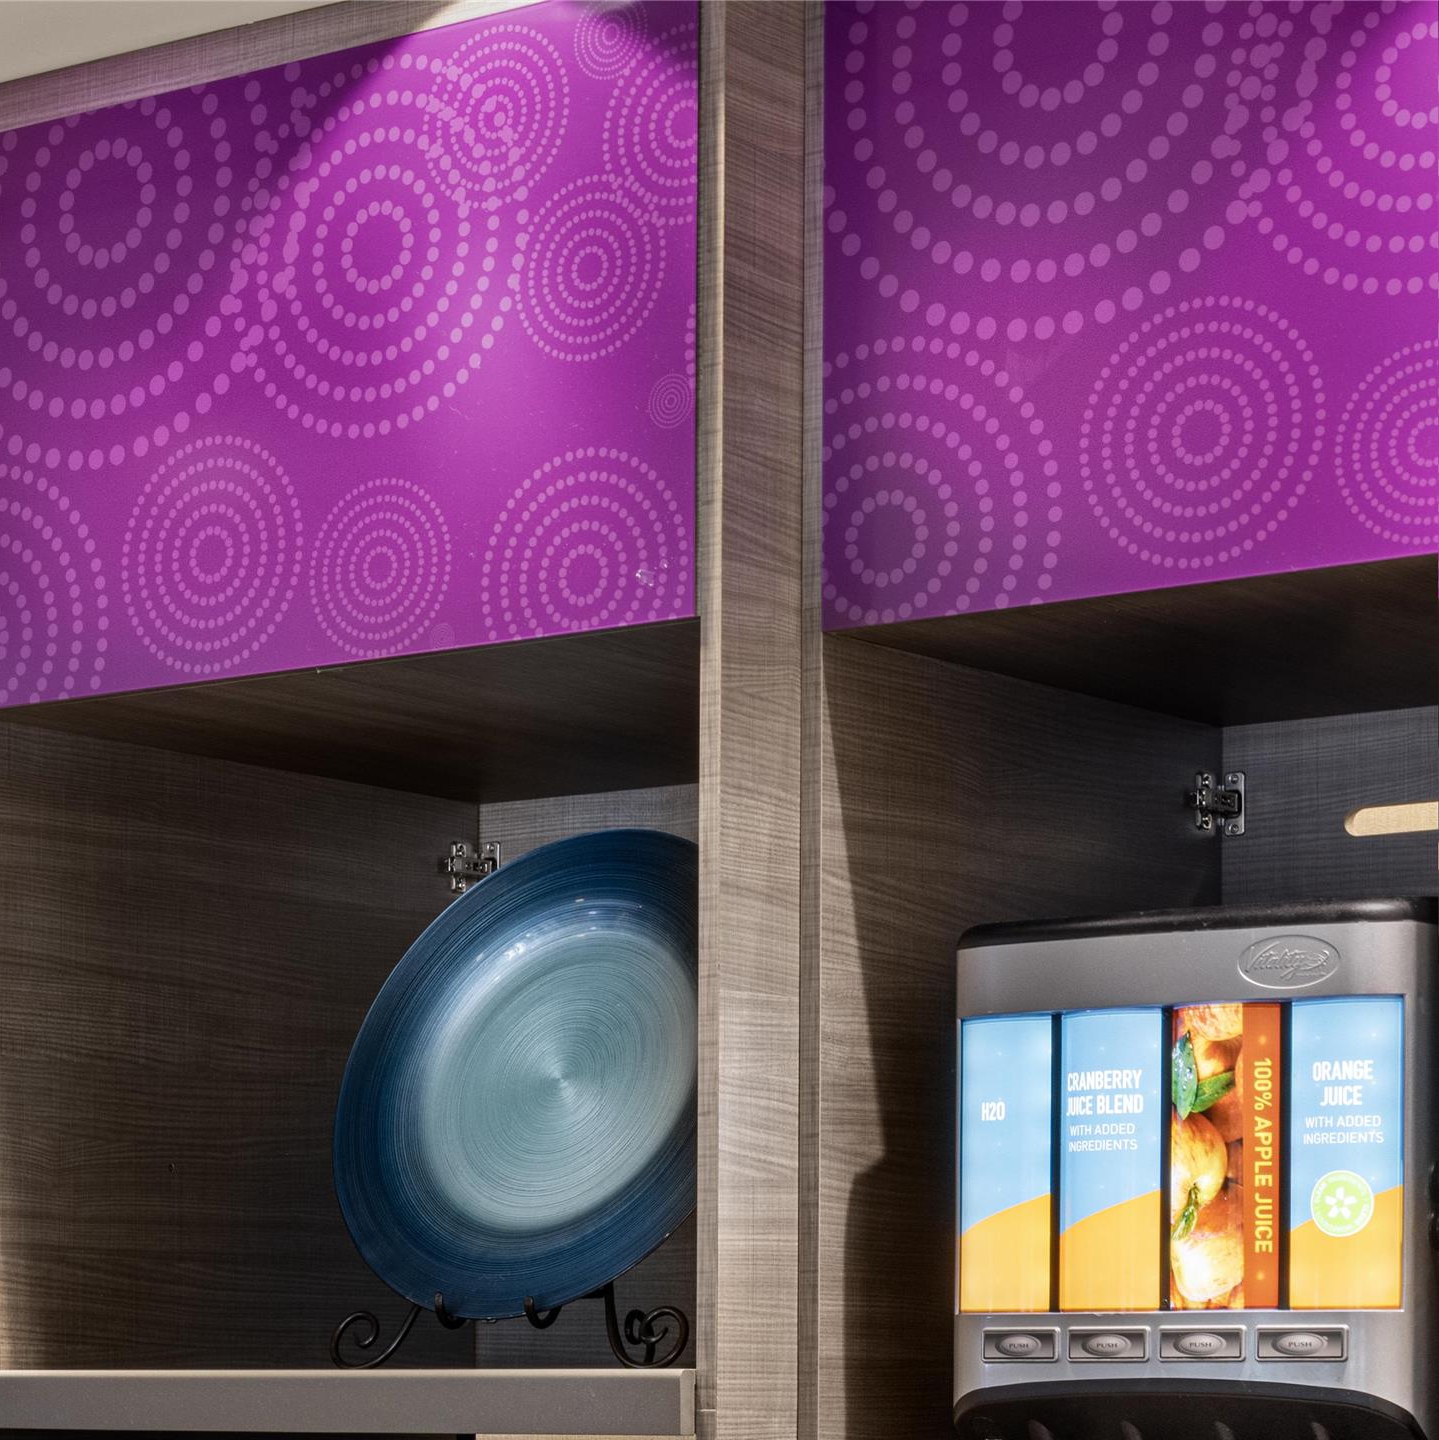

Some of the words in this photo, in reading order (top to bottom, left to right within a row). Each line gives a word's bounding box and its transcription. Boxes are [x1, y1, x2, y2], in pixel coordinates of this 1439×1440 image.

[1067, 1069, 1143, 1092] CRANBERRY
[1312, 1060, 1374, 1082] ORANGE
[1254, 1057, 1272, 1110] 100%
[1066, 1096, 1094, 1117] JUICE
[1096, 1094, 1144, 1115] BLEND
[1320, 1085, 1363, 1107] JUICE
[981, 1101, 1006, 1121] H2O
[1305, 1116, 1333, 1128] WITH
[1336, 1115, 1382, 1128] ADDED
[1070, 1124, 1092, 1137] WITH
[1094, 1123, 1136, 1136] ADDED
[1303, 1130, 1384, 1145] INGREDIENTS
[1068, 1138, 1138, 1153] INGREDIENTS
[1254, 1116, 1272, 1188] APPLE
[1254, 1192, 1272, 1253] JUICE
